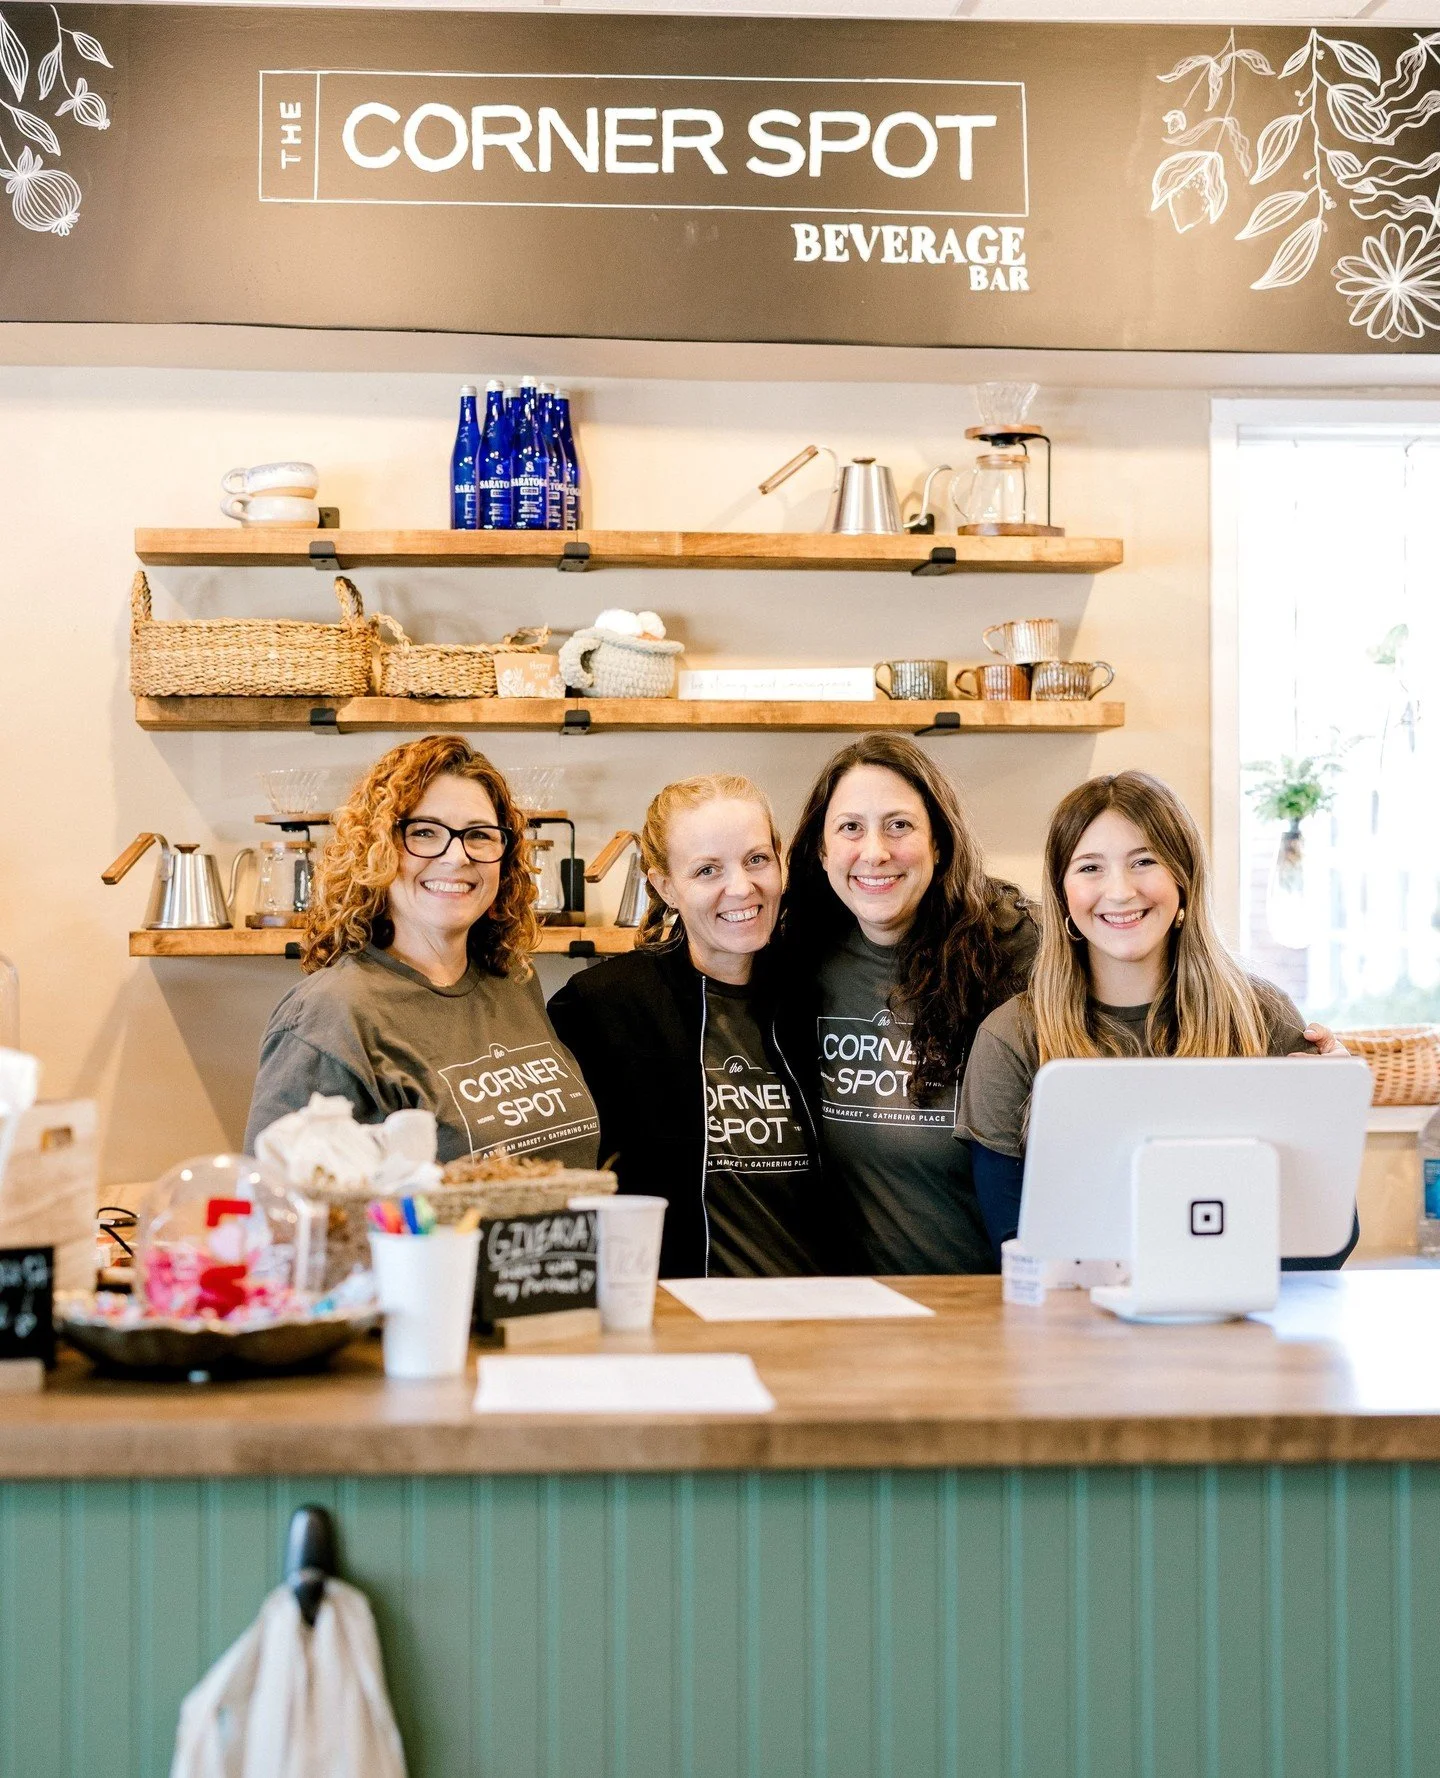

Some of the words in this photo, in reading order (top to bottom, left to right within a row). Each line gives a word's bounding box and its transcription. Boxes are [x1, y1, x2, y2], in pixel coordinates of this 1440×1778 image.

[280, 101, 302, 170] THE
[341, 101, 729, 175] CORNER
[745, 108, 997, 181] SPOT
[790, 223, 1027, 266] BEVERAGE
[969, 265, 1030, 292] BAR
[823, 1033, 918, 1066] CORNE
[459, 1057, 569, 1103] CORNER
[728, 1062, 744, 1074] the
[497, 1087, 567, 1127] SPOT
[836, 1109, 863, 1118] MARKET
[873, 1112, 916, 1121] GATHERING
[517, 1136, 541, 1149] MARKET
[548, 1127, 582, 1140] GATHERING
[708, 1115, 789, 1145] SPOT
[750, 1160, 792, 1168] GATHERING
